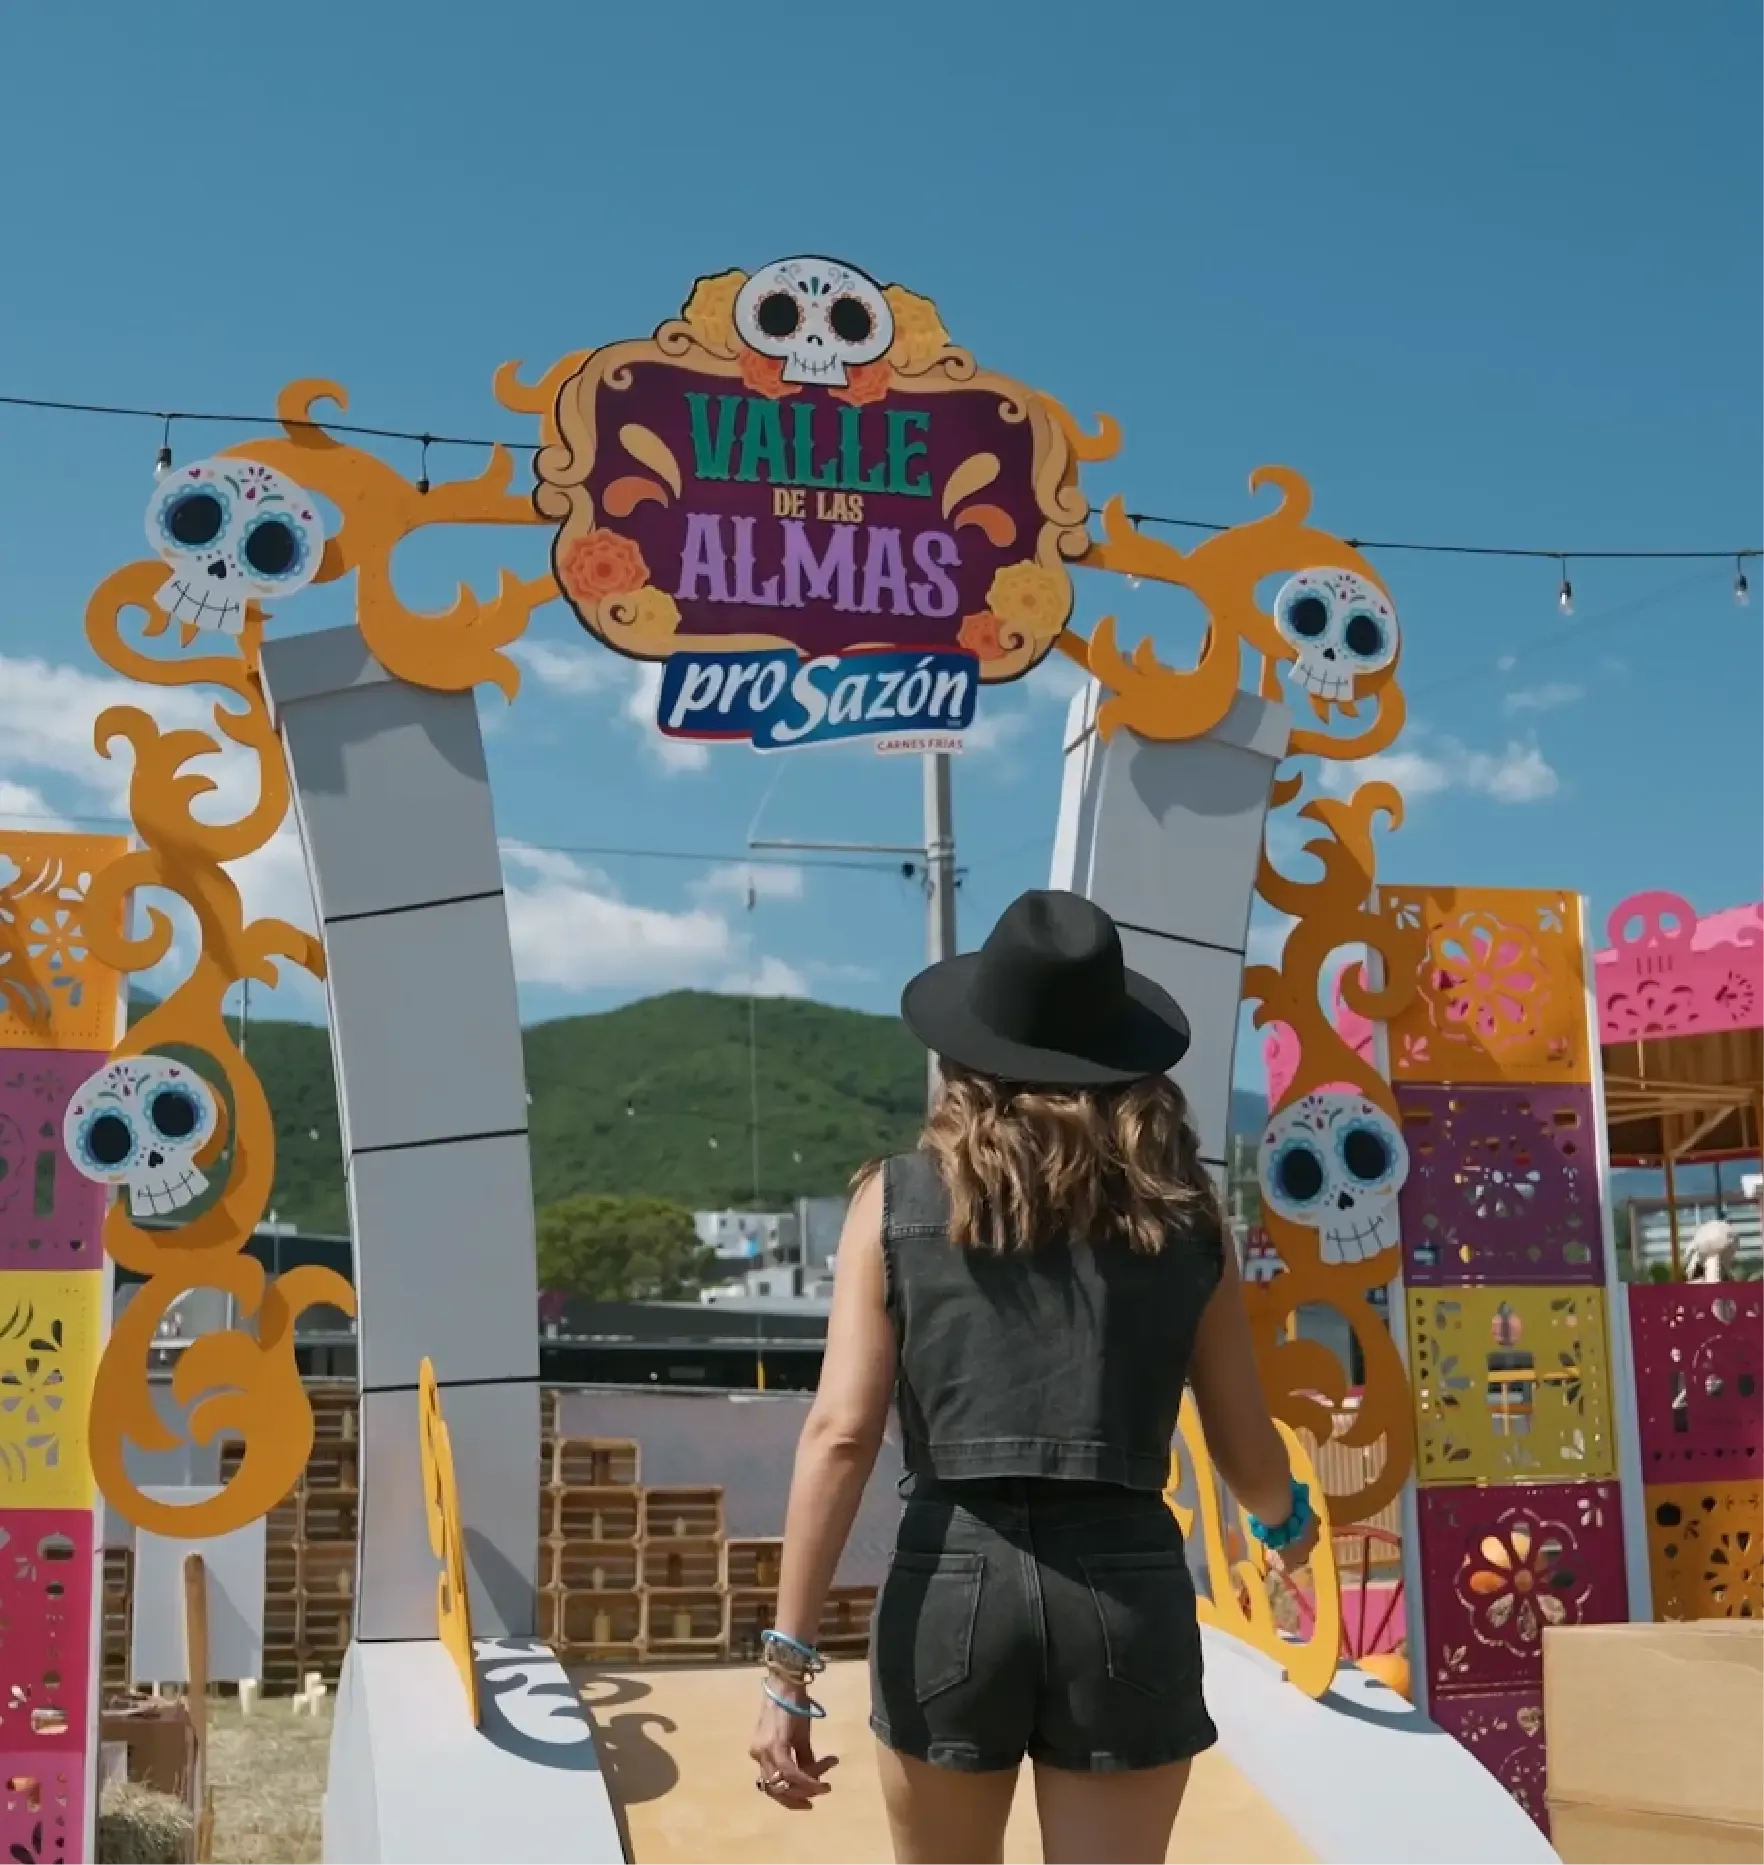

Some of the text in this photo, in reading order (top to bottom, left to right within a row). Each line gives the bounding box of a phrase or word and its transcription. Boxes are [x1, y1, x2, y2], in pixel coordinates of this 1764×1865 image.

[685, 392, 932, 498] VALLE
[773, 488, 865, 524] DE LAS
[673, 513, 962, 618] ALMAS
[877, 740, 925, 750] CARNES
